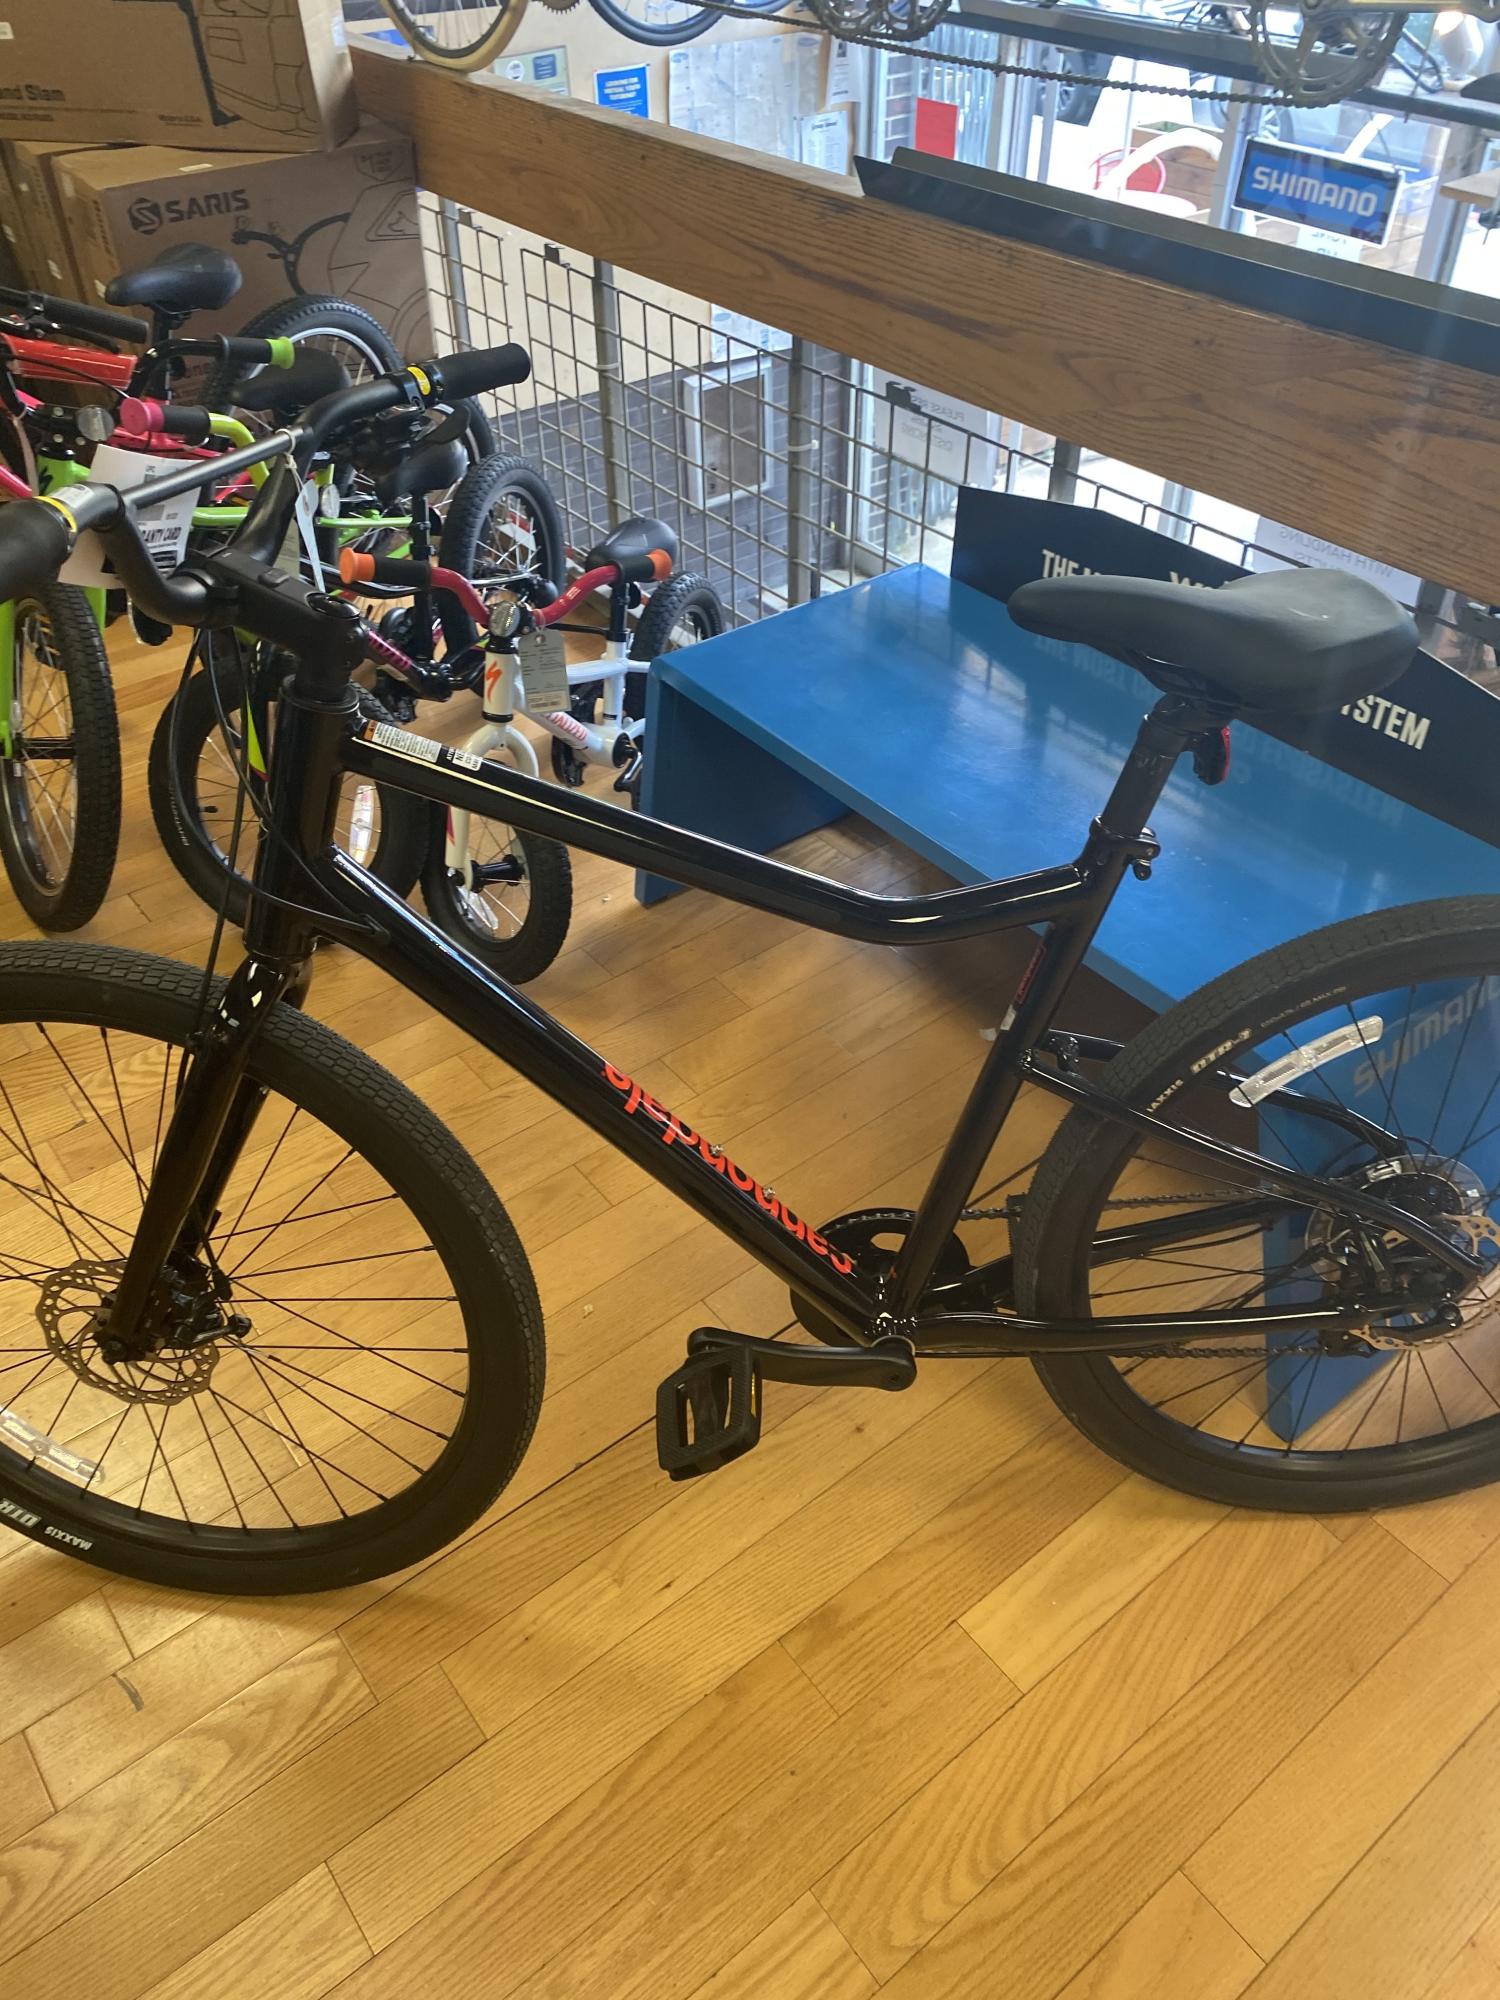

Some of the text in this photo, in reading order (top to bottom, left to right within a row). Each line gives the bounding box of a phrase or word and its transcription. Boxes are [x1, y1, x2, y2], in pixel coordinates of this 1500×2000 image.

[165, 189, 250, 223] SARIS
[1252, 165, 1378, 217] SHIMANO
[1042, 549, 1080, 578] THE
[1341, 694, 1431, 750] STEM
[1146, 1079, 1184, 1112] AXXIS
[602, 1061, 855, 1274] cannondale
[44, 1526, 93, 1551] MAXXIS
